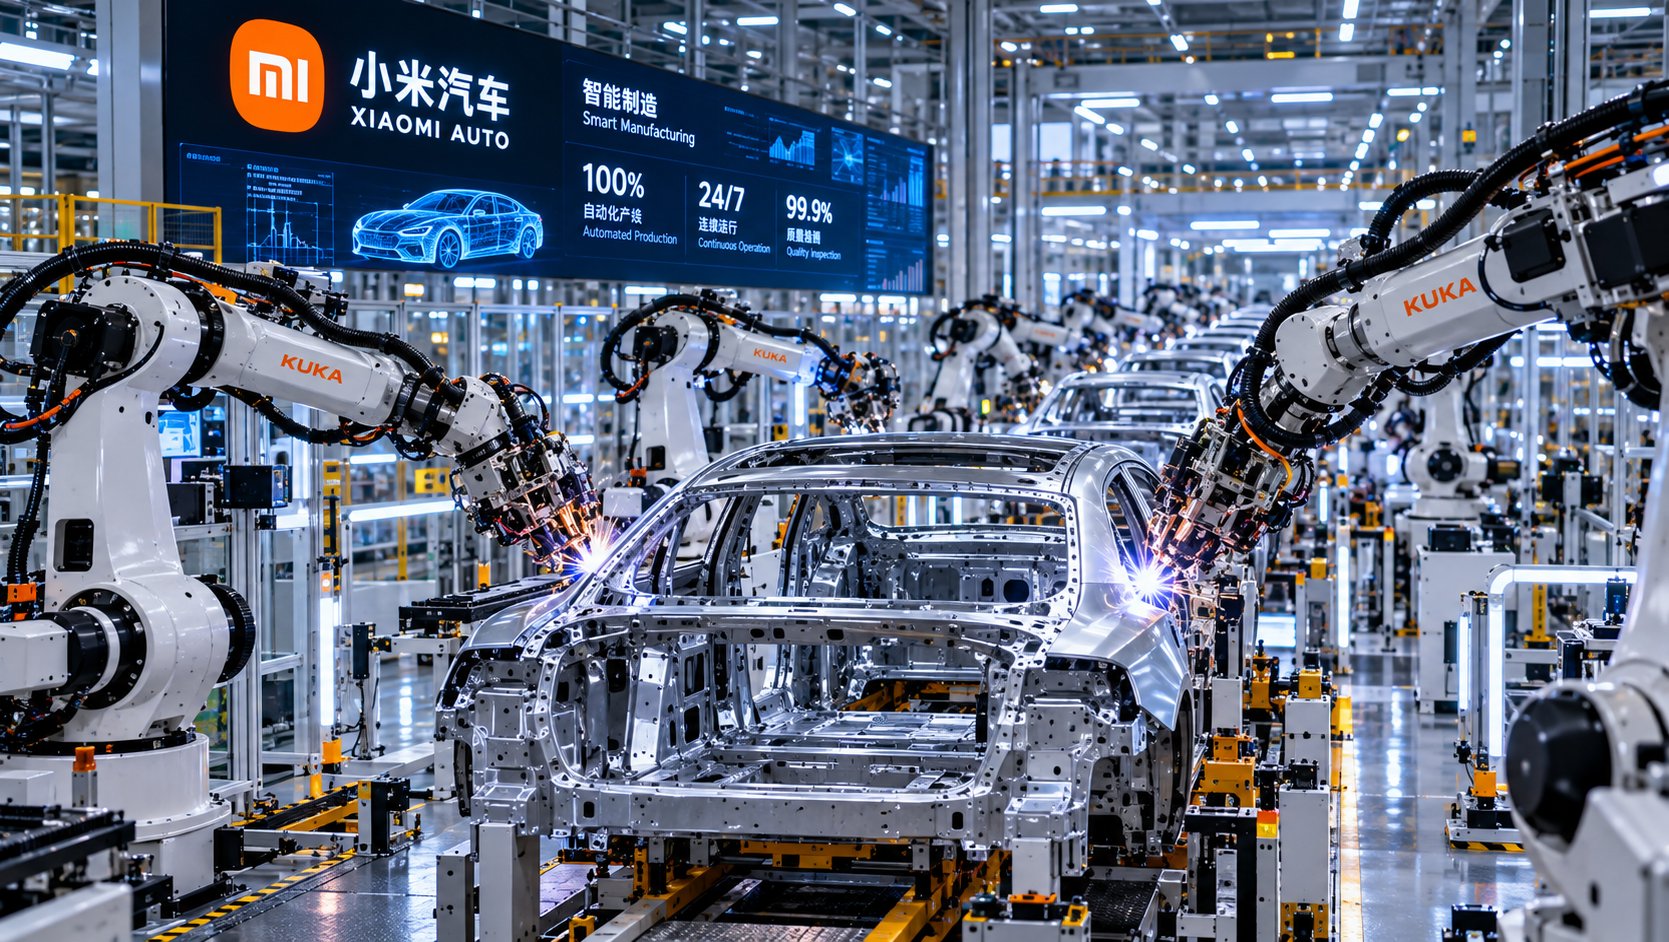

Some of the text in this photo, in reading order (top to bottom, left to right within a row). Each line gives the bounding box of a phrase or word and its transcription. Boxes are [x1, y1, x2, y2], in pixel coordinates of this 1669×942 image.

[350, 50, 510, 122] 小米汽车
[583, 78, 657, 118] 智能制造
[351, 105, 509, 149] XIAOMI AUTO
[583, 110, 695, 148] Smart Manufacturing
[583, 163, 645, 199] 100%
[699, 181, 745, 212] 24/7
[786, 194, 833, 224] 99.9%
[583, 225, 678, 245] Automated Production
[738, 241, 771, 254] Operation
[786, 246, 809, 260] Quality
[1403, 277, 1477, 317] KUKA
[281, 354, 343, 384] KUKA
[753, 348, 787, 364] KUKA
